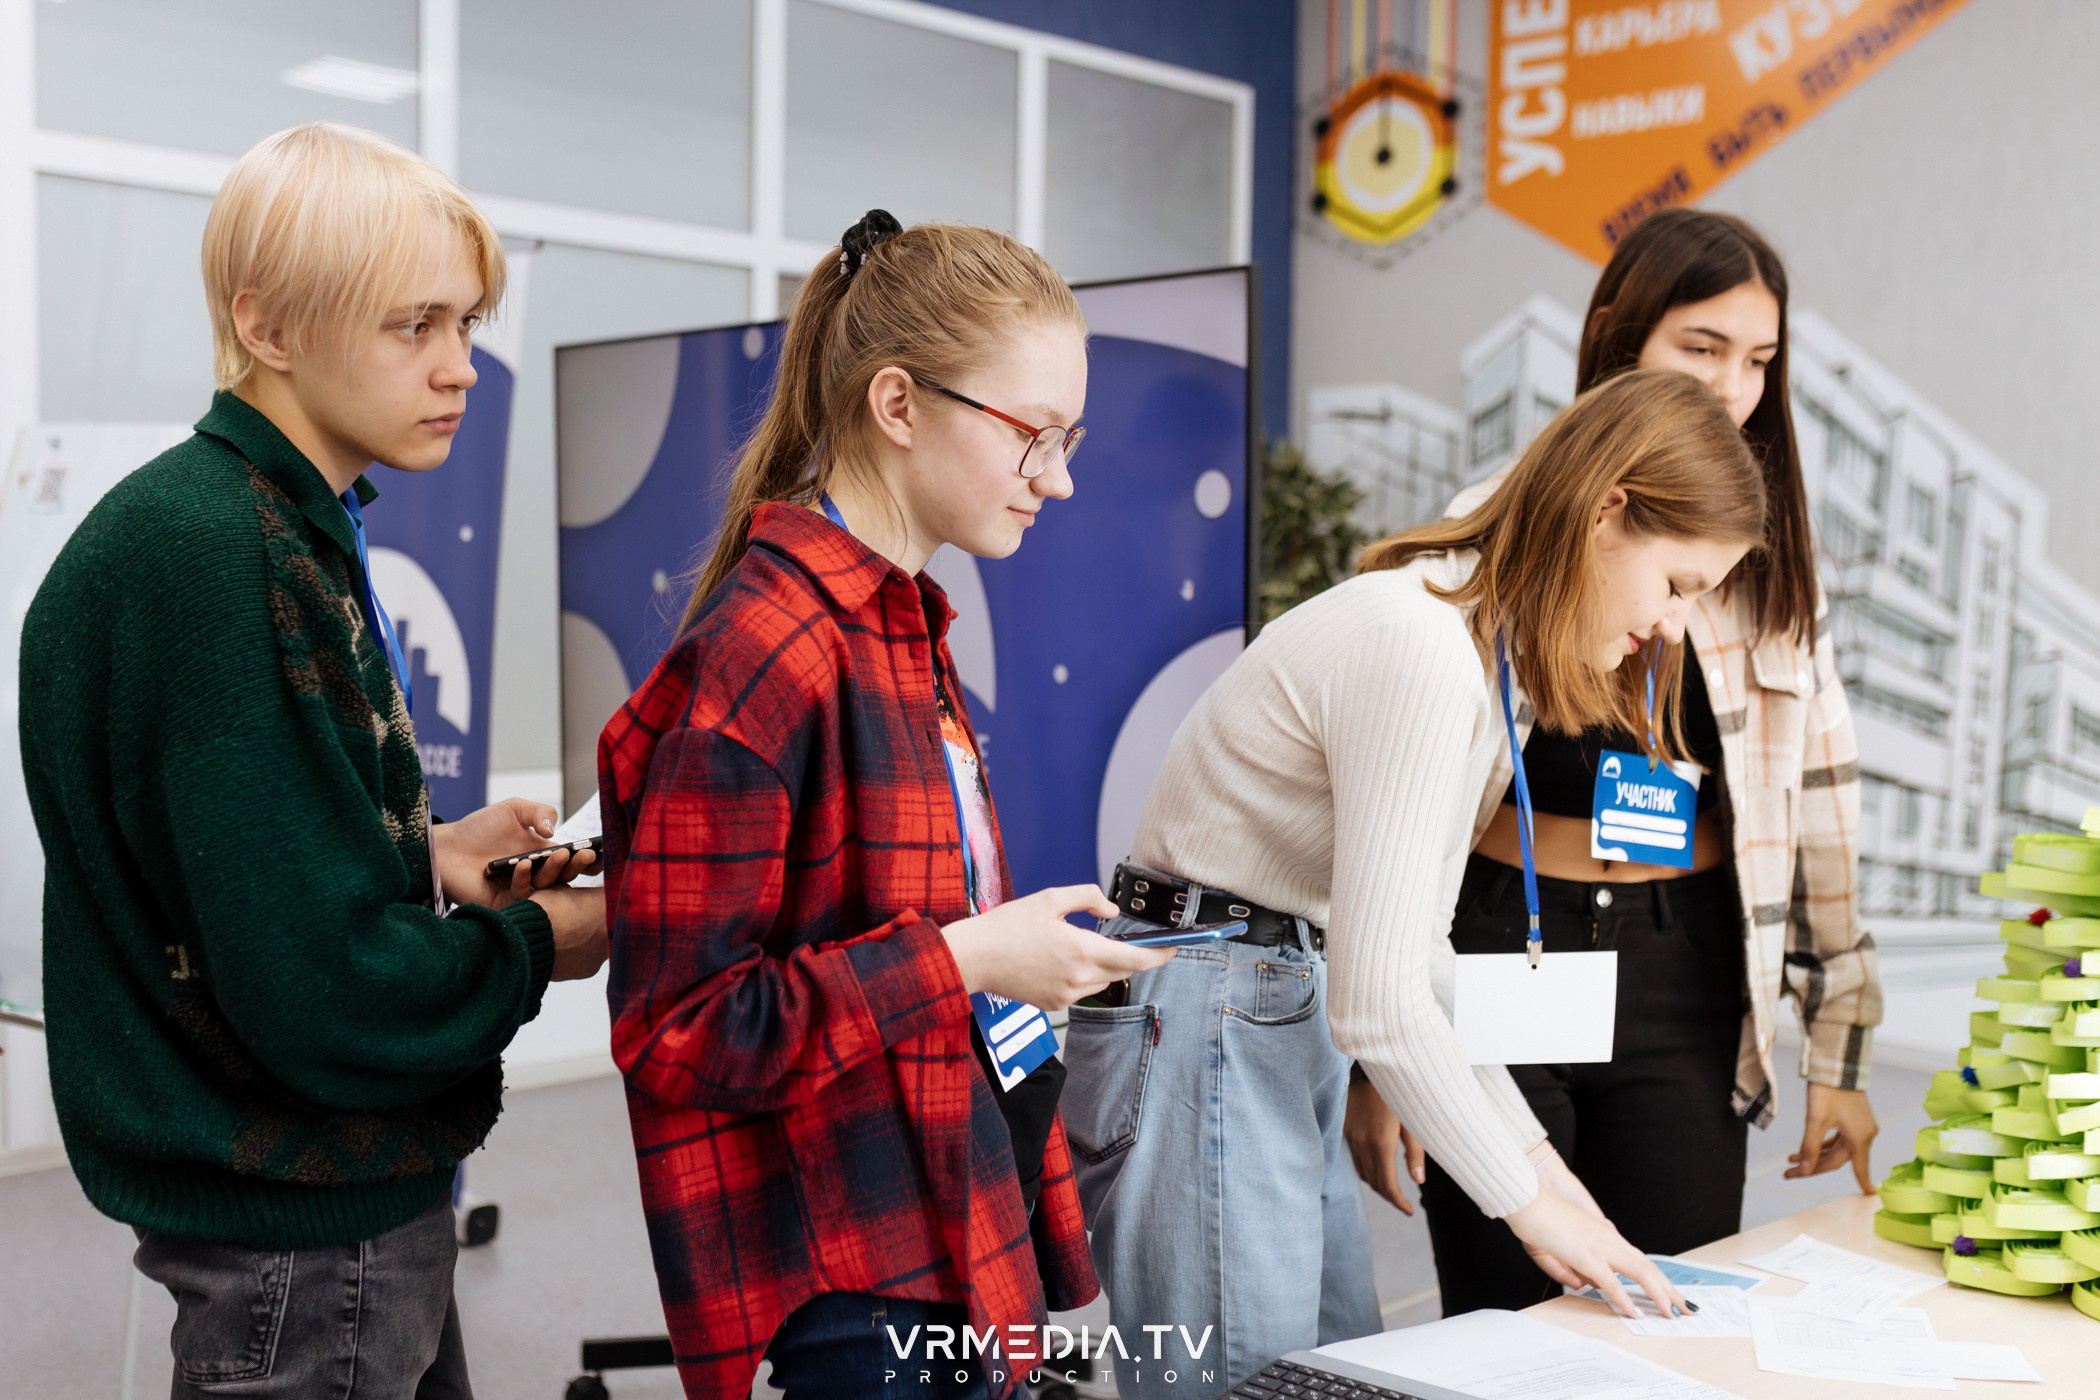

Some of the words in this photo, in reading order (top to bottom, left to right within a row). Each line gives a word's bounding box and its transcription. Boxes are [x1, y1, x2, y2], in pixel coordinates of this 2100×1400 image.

[1573, 0, 1718, 57] КАРЬЕРА
[1571, 81, 1706, 140] НАВЫКИ
[1706, 100, 1790, 170] БЫТЬ
[1614, 780, 1678, 814] УЧАСТНИК
